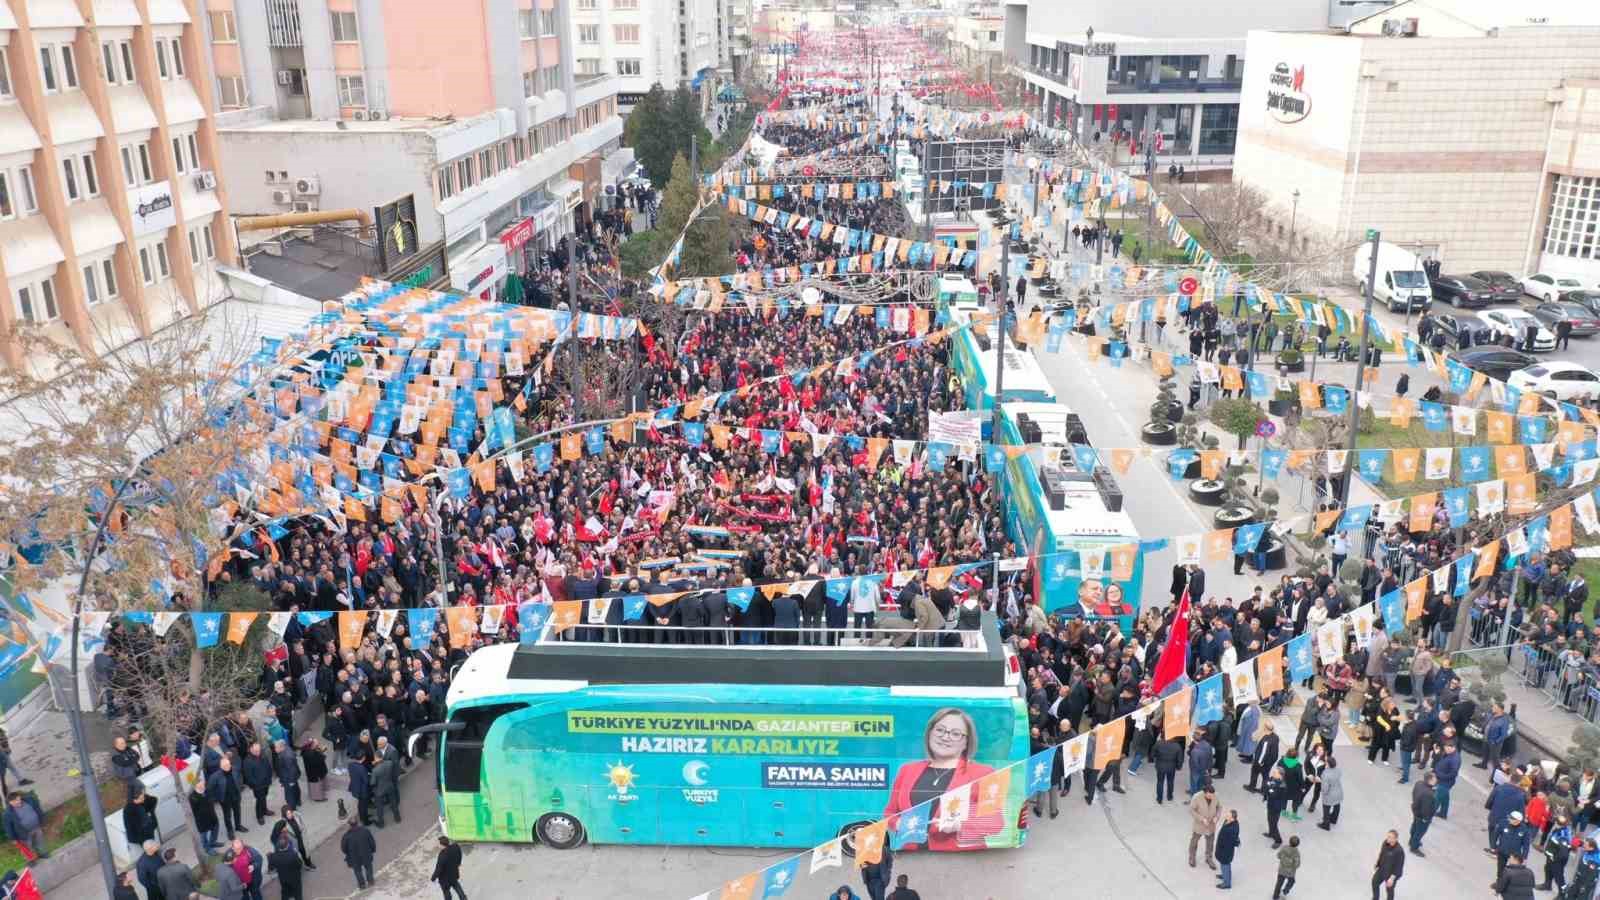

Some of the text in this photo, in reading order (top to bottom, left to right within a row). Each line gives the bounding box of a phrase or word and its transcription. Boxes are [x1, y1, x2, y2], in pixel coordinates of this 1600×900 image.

[571, 716, 646, 729] TÜRKİYE
[854, 720, 890, 736] İÇİN
[622, 736, 839, 756] HAZIRIZ KARARLIYIZ
[768, 766, 827, 781] FATMA
